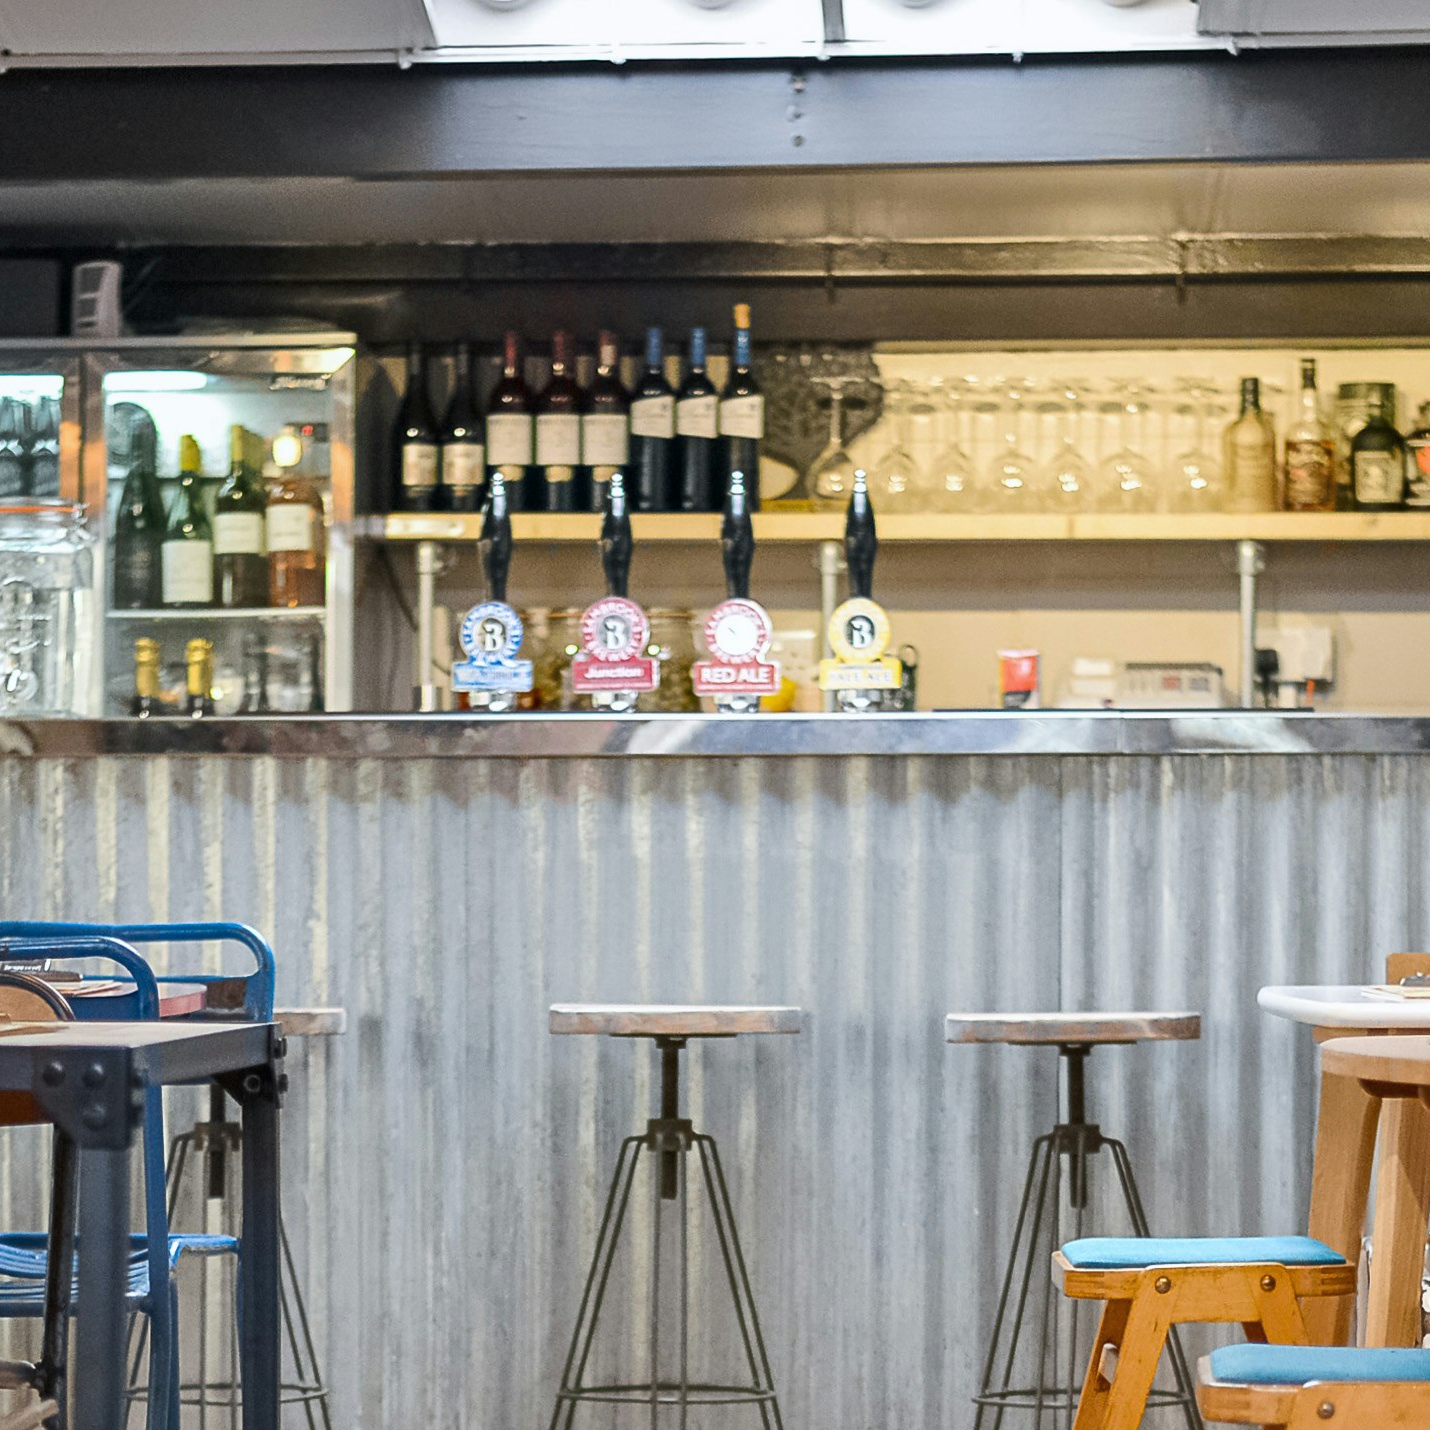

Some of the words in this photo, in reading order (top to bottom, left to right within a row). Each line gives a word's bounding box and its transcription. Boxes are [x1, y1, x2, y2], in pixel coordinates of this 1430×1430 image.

[584, 665, 644, 679] Junction
[700, 667, 736, 684] RED
[737, 667, 771, 684] ALE
